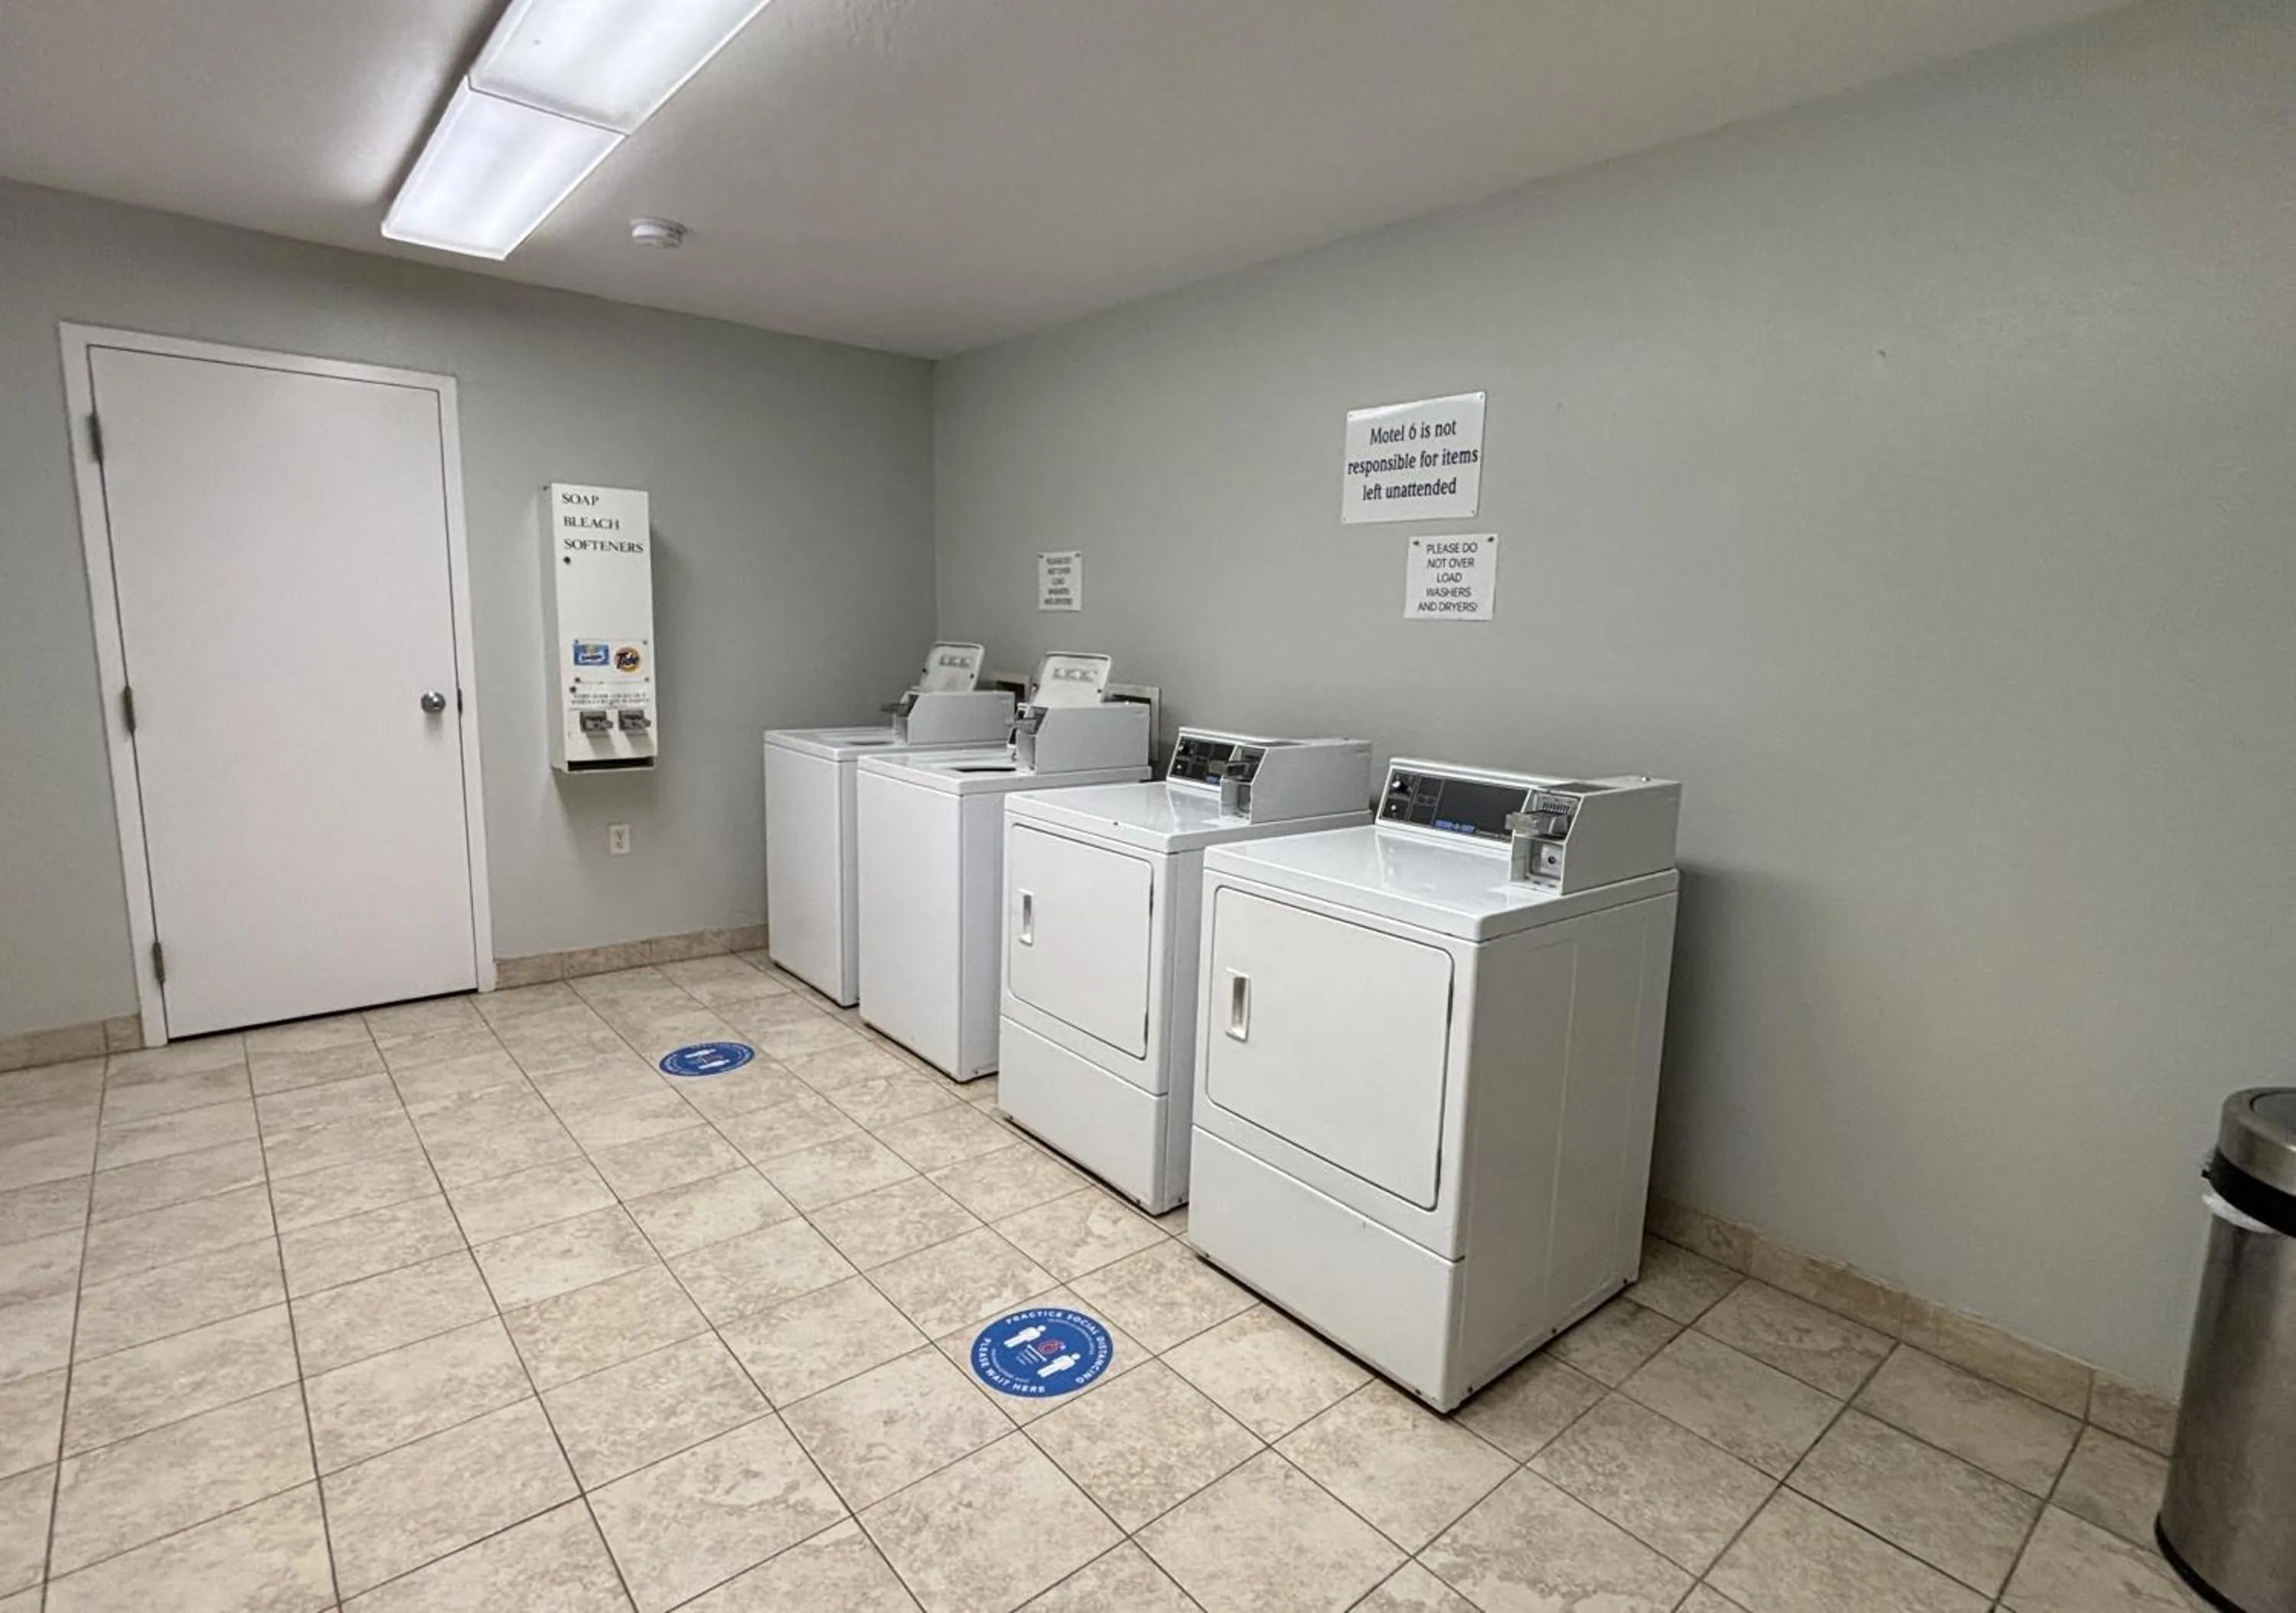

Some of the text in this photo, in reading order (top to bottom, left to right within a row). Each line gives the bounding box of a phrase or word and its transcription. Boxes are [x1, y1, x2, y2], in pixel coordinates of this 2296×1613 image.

[1370, 420, 1457, 445] Motel 6 is not
[1347, 448, 1479, 477] responsible for items
[1362, 477, 1457, 501] left unattended
[562, 492, 599, 506] SOAP
[563, 516, 620, 530] BLEACH
[563, 539, 644, 553] SOFTENERS
[1426, 542, 1479, 554] PLEASE DO
[1427, 557, 1475, 569] NOT OVER
[1437, 572, 1463, 583] LOAD
[1426, 586, 1472, 598] WASHERS
[1417, 601, 1437, 611] AND
[1005, 1310, 1063, 1325] PRACTICE
[1066, 1313, 1101, 1335] SOCIAL
[978, 1337, 992, 1368] PLEASE
[985, 1367, 1011, 1387] WAIT
[1012, 1383, 1045, 1393] HERE
[1075, 1336, 1108, 1384] DISTANCING
